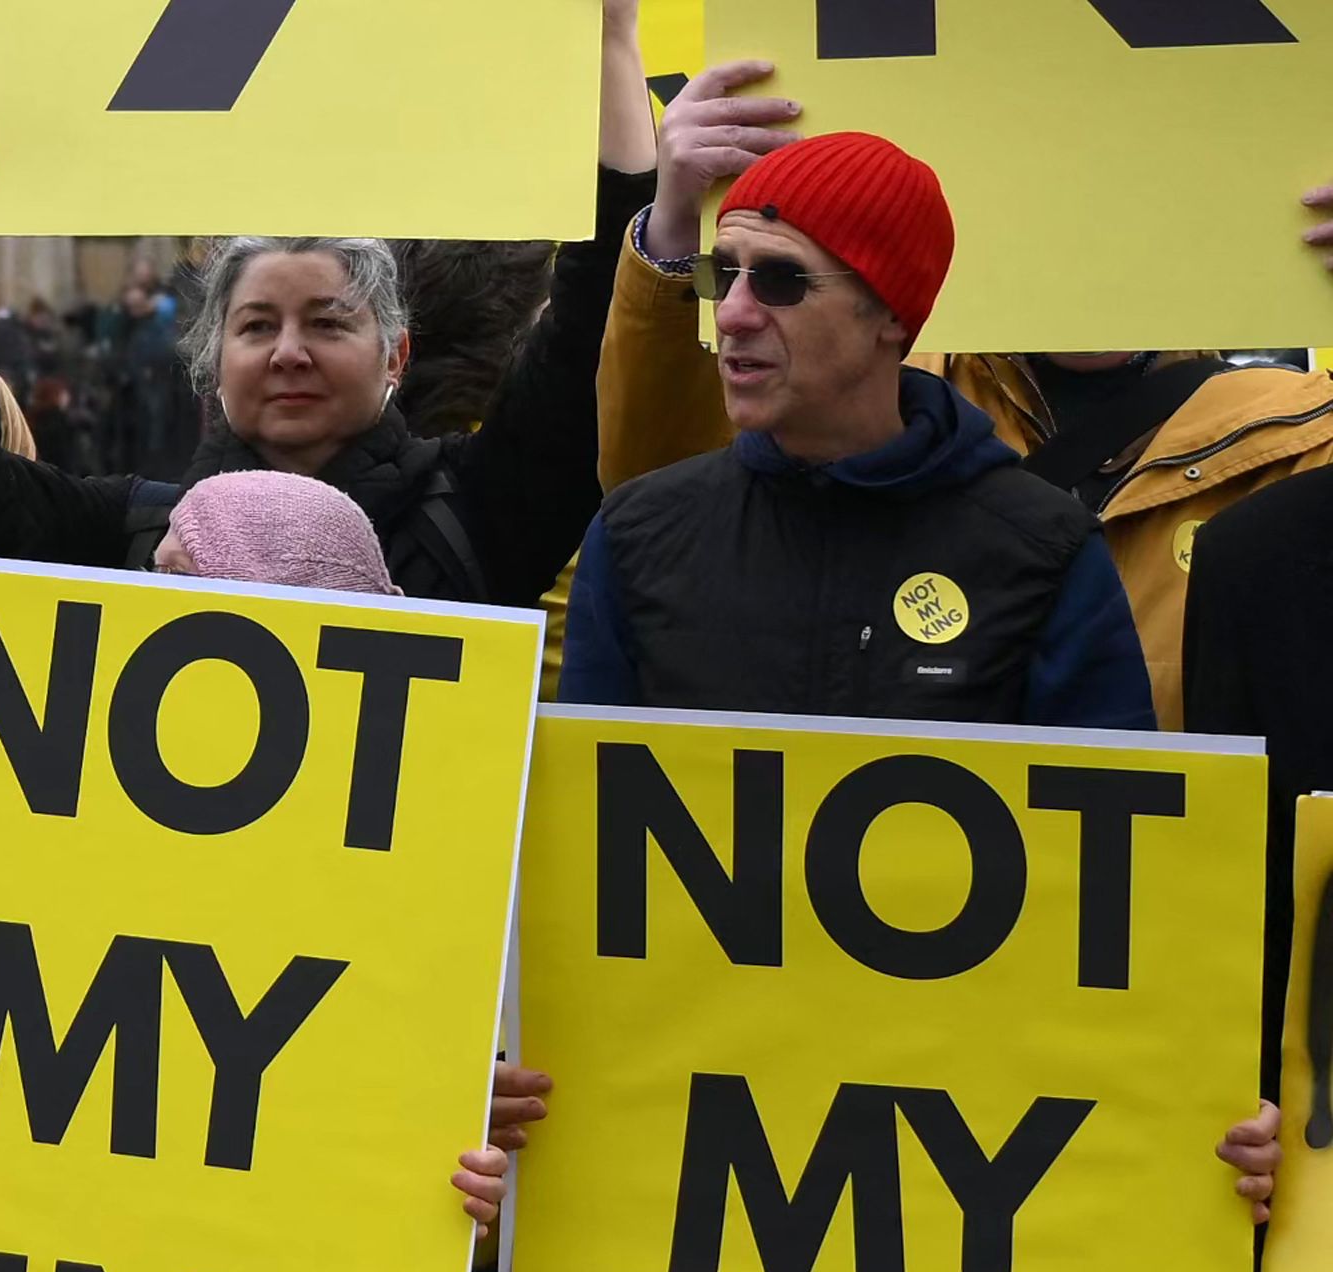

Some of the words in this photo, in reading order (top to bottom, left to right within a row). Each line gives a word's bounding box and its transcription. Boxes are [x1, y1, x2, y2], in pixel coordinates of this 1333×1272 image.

[901, 578, 937, 608] NOT
[916, 597, 942, 621] MY
[919, 608, 963, 639] KING
[596, 741, 1187, 992] NOT
